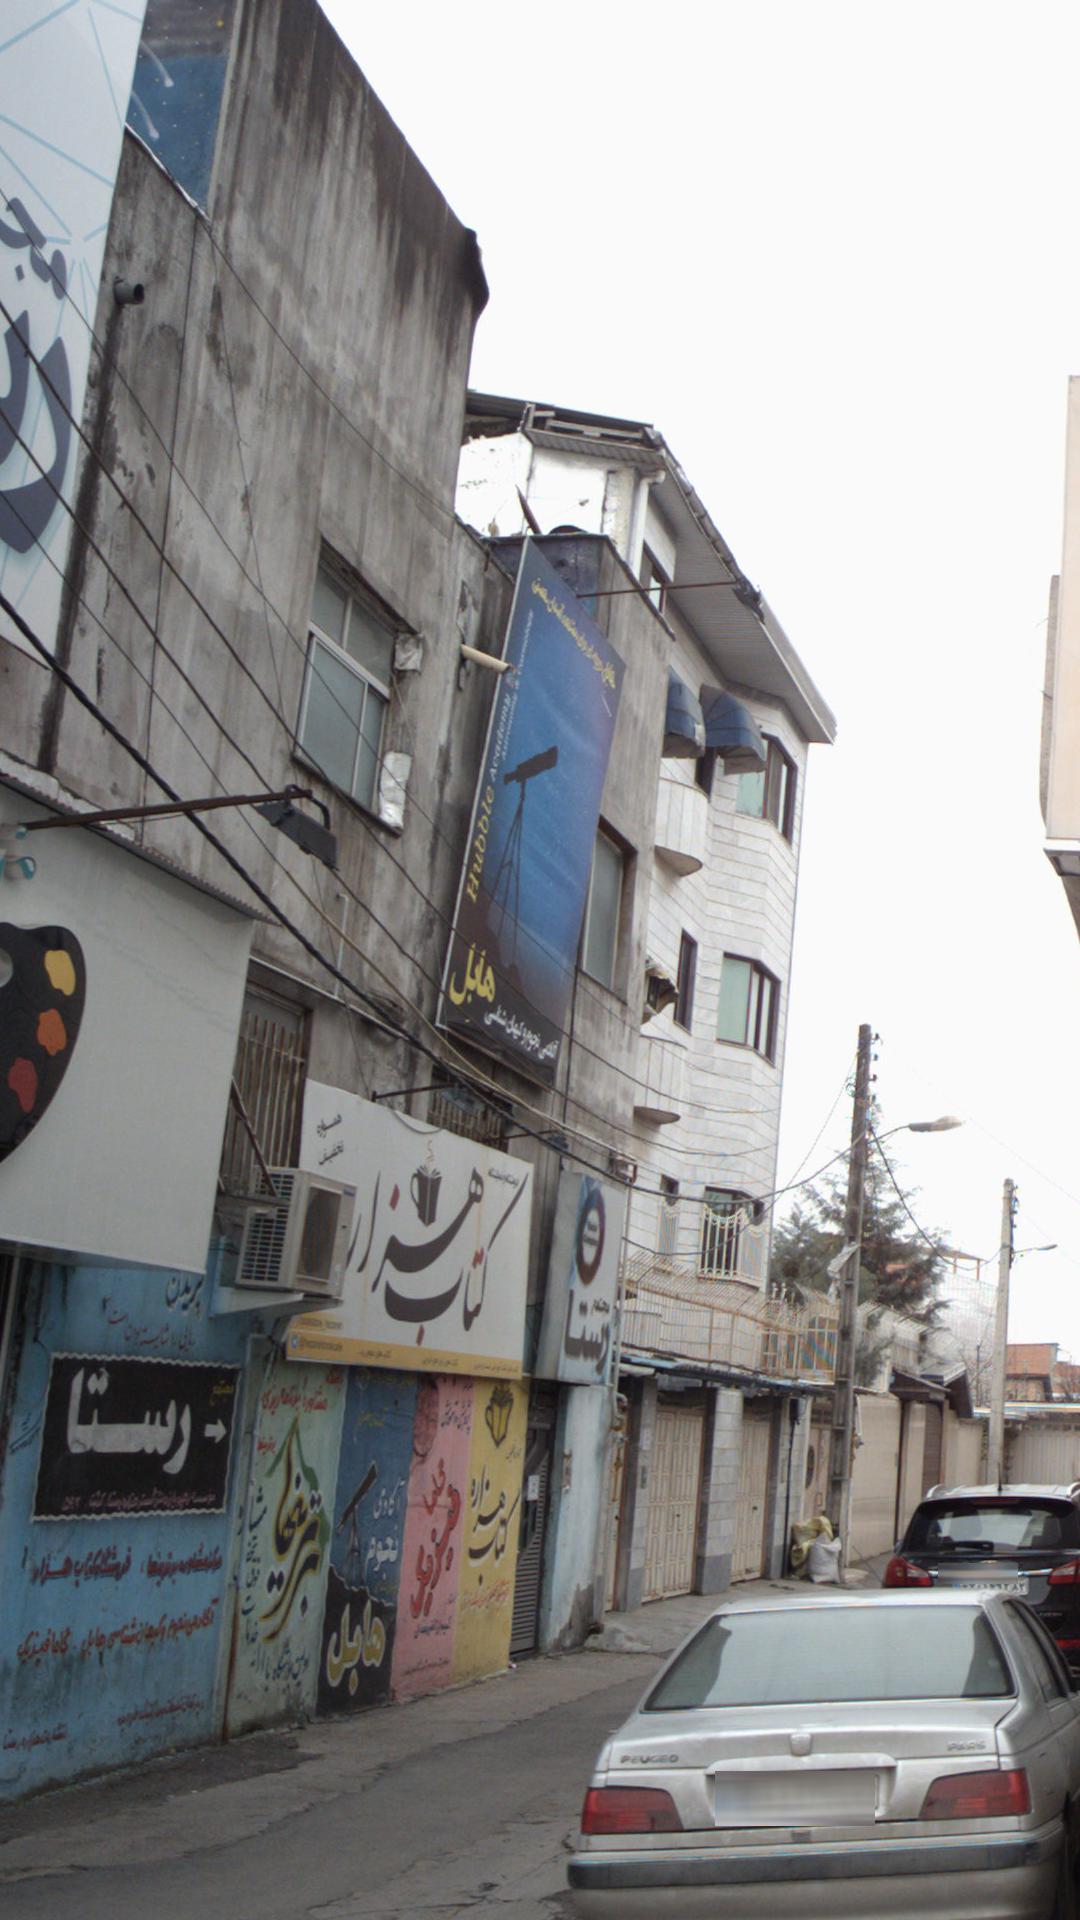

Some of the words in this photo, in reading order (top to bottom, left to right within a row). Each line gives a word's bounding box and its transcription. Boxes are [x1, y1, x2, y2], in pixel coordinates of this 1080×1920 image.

[466, 784, 496, 904] Hubble
[489, 689, 512, 781] Academy
[449, 943, 496, 1005] هابل
[346, 1165, 485, 1294] هزار
[384, 1172, 529, 1347] کتاب
[565, 1289, 611, 1376] رستا
[67, 1367, 192, 1475] رستا
[326, 1598, 386, 1697] هابل
